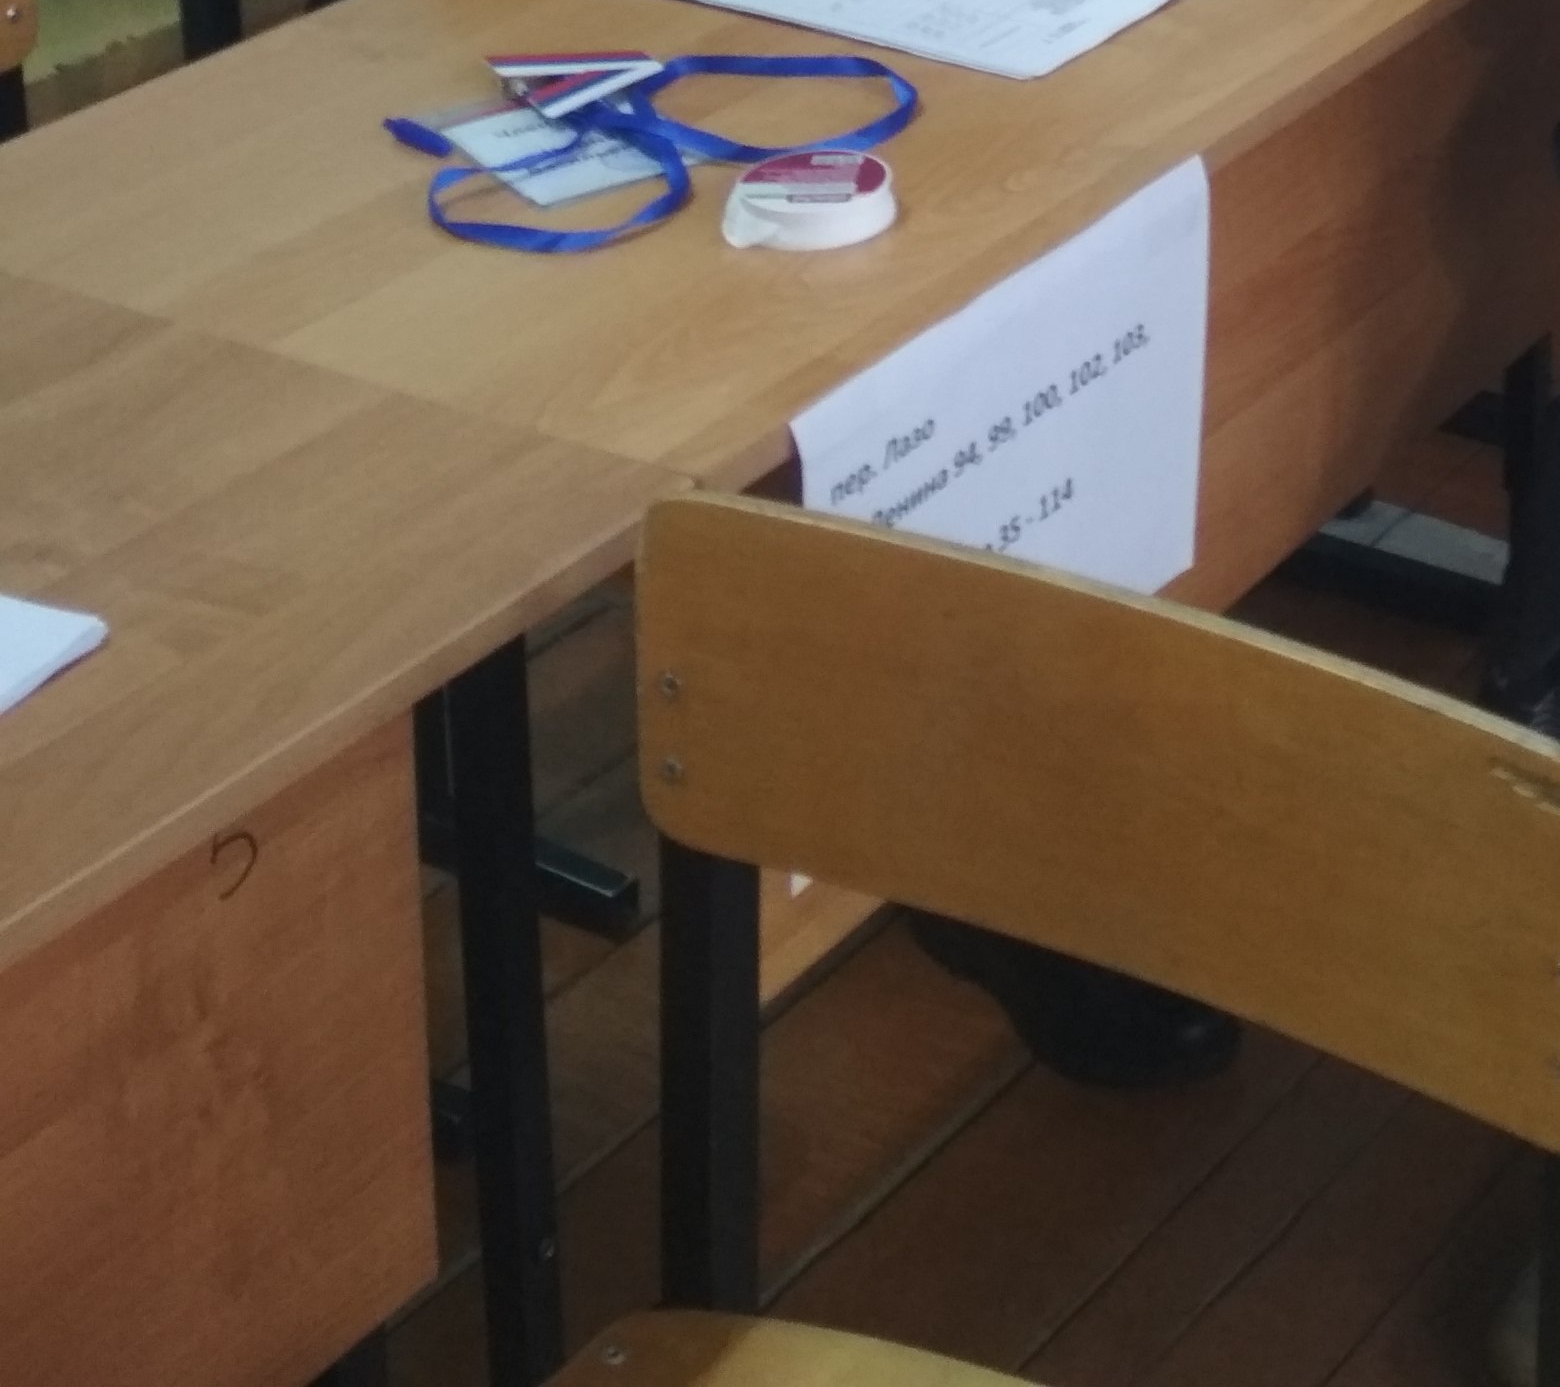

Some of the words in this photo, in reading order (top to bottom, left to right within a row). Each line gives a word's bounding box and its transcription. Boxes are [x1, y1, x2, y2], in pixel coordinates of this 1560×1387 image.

[830, 464, 879, 507] пер.
[882, 418, 936, 470] Лазо
[1039, 477, 1074, 523] 114
